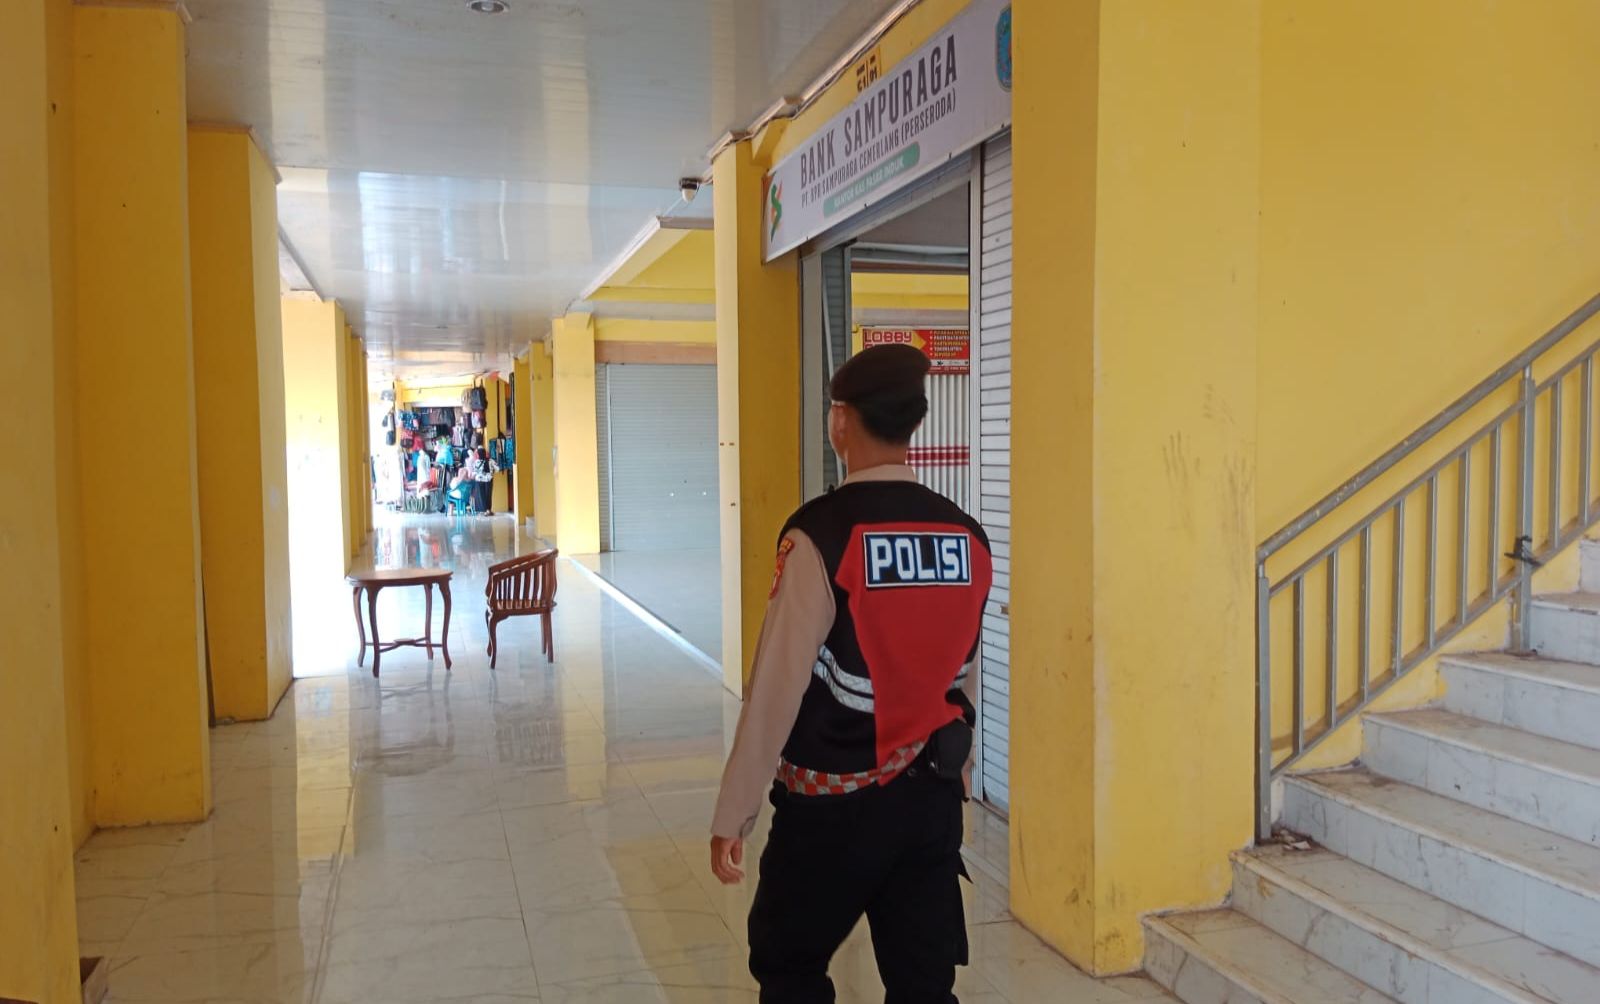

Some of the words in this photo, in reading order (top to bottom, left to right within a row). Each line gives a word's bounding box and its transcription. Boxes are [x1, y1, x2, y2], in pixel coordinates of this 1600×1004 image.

[801, 128, 835, 189] BANK
[844, 34, 957, 157] SAMPURAGA
[822, 159, 857, 198] SAMPURAGA
[859, 127, 899, 171] CEMERLANG
[901, 87, 956, 146] (PERSERODA)
[864, 331, 912, 342] LOBBY
[869, 537, 968, 581] POLISI
